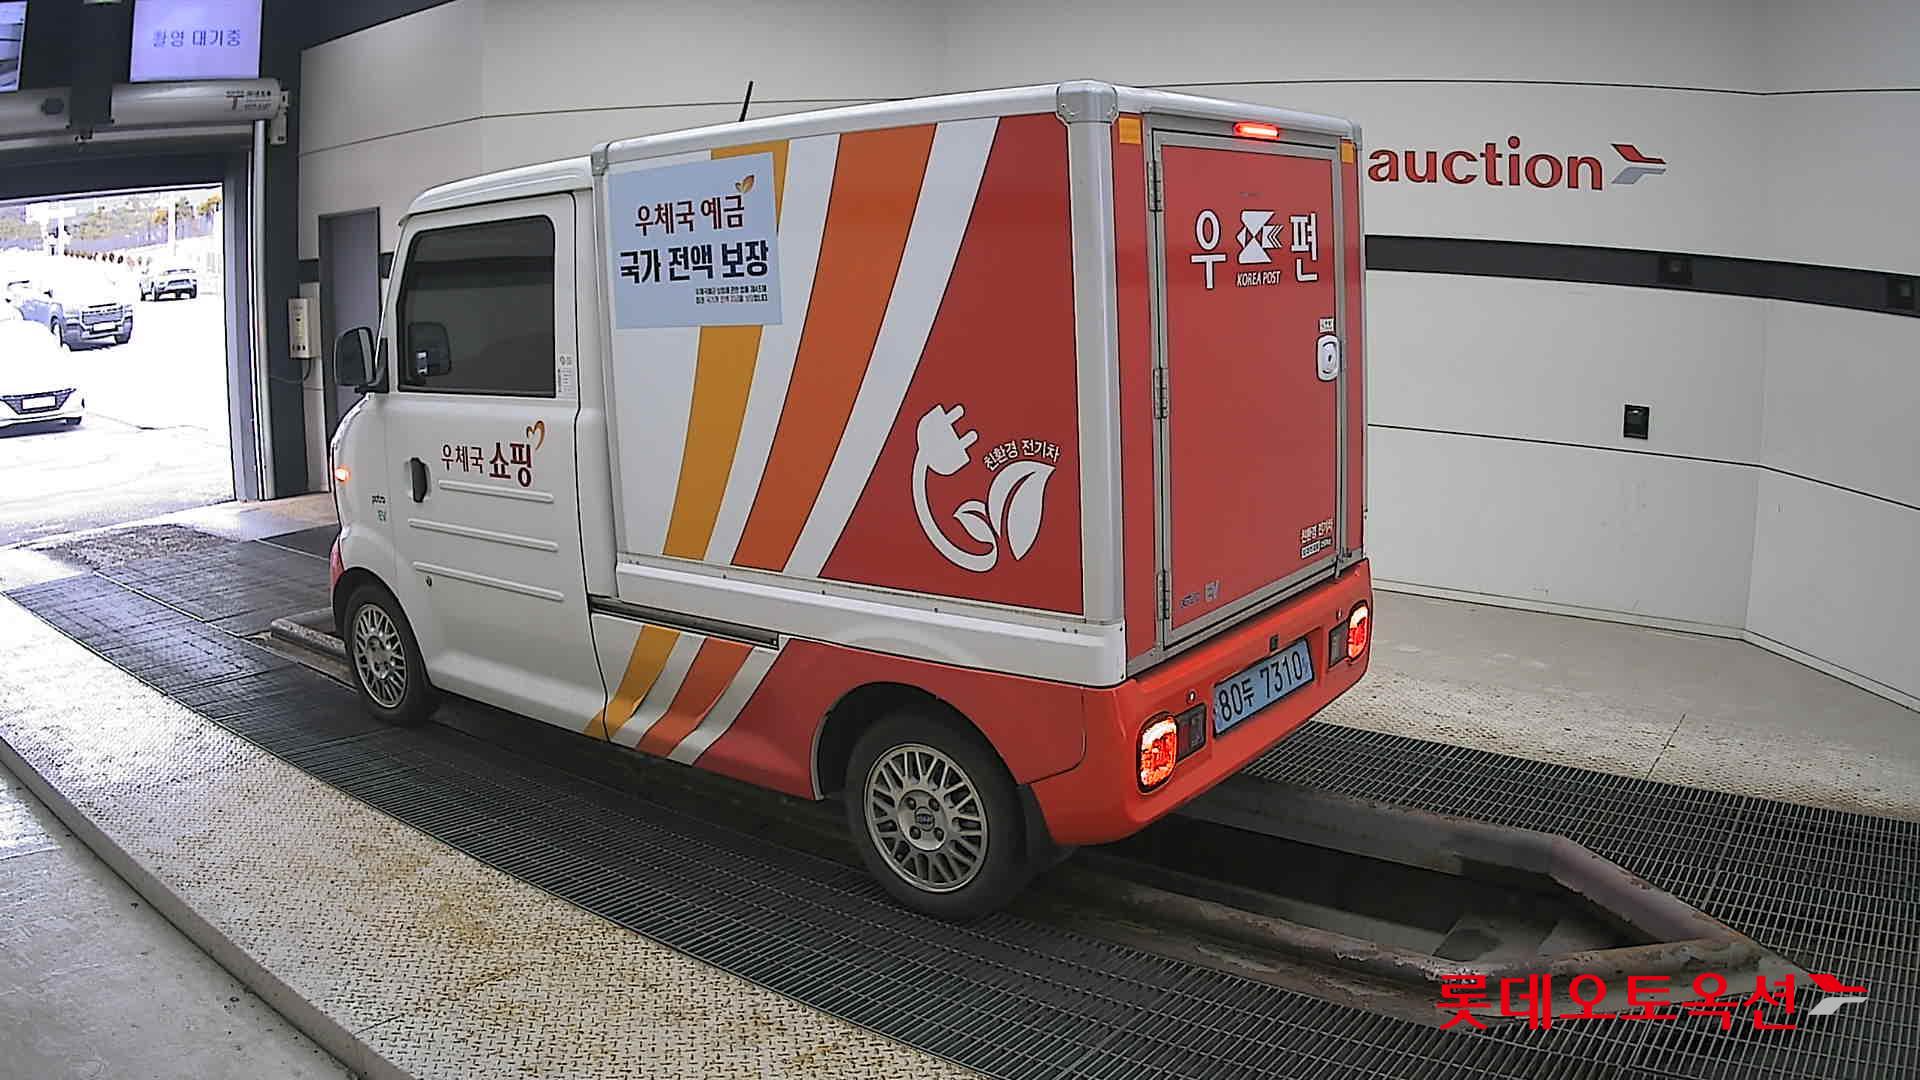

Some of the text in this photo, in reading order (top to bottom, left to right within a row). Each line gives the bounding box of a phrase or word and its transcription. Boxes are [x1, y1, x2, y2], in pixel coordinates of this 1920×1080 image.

[192, 29, 240, 48] 대기중
[1367, 135, 1603, 191] auction
[635, 195, 744, 236] 우체국 예금
[620, 240, 769, 284] 국가 전액 보장
[1191, 209, 1318, 289] 우 편
[1237, 270, 1280, 287] KOREA POST
[441, 442, 533, 487] 우체국 쇼핑
[983, 439, 1060, 471] 친환경 전기차
[1219, 651, 1302, 721] 80두 7310
